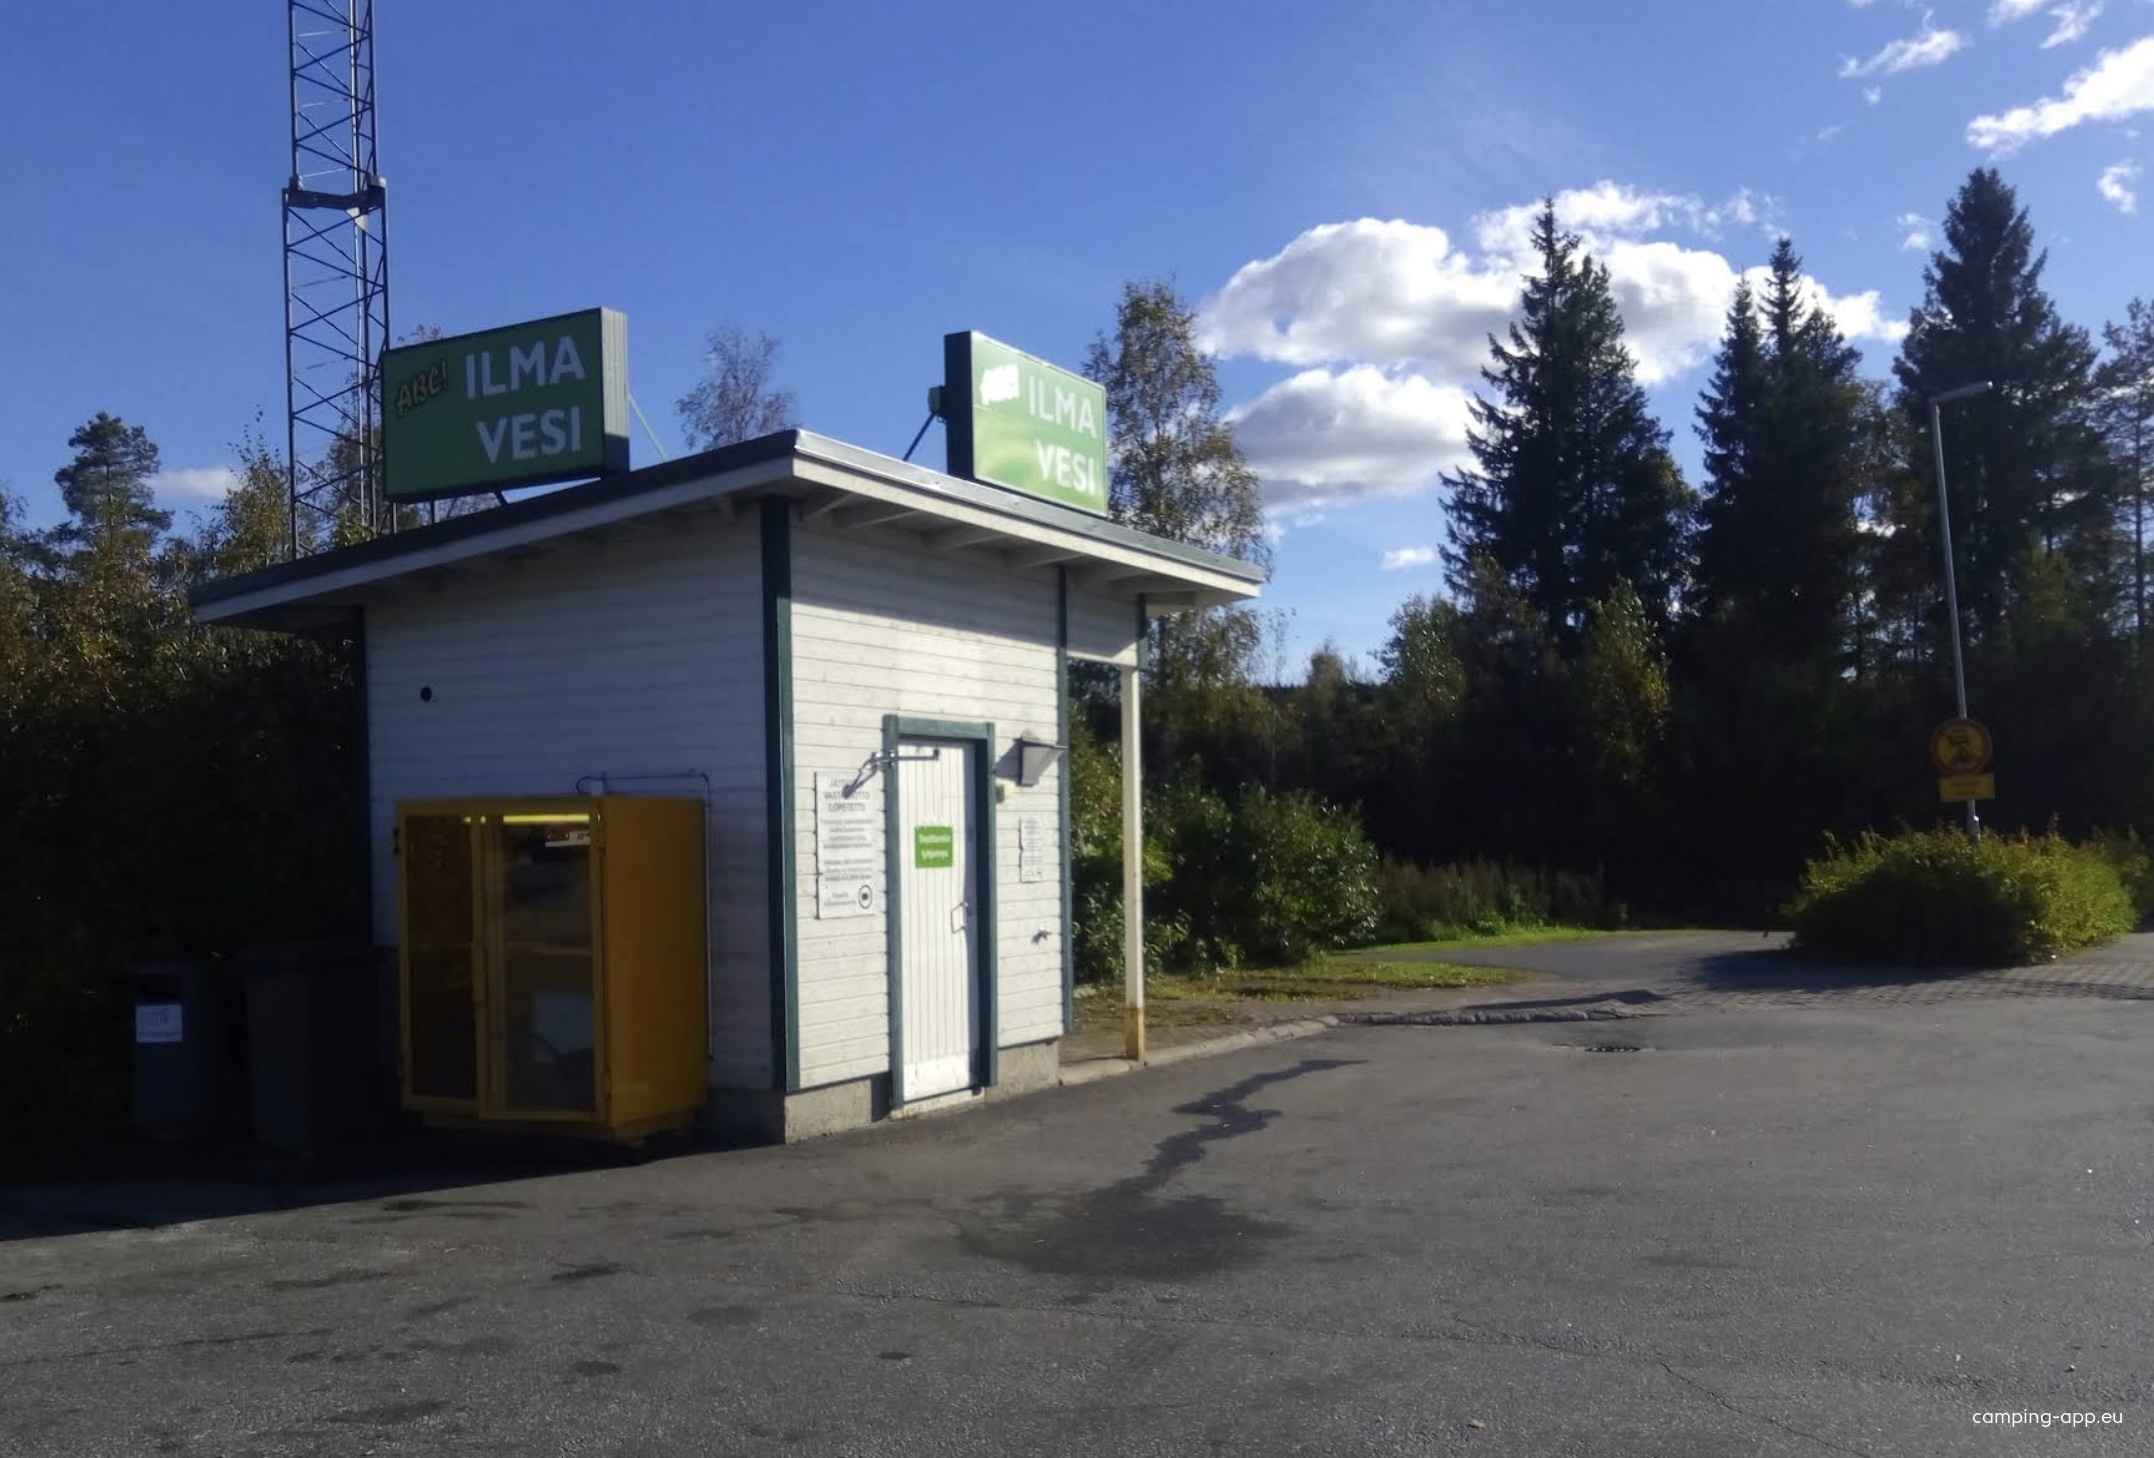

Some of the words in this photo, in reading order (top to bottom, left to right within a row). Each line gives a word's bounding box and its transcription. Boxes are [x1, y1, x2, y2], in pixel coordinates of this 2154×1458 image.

[397, 359, 448, 416] ABC!
[465, 336, 587, 398] ILMA
[476, 406, 582, 464] VESI
[1029, 376, 1097, 438] ILMA
[1036, 440, 1096, 495] VESI
